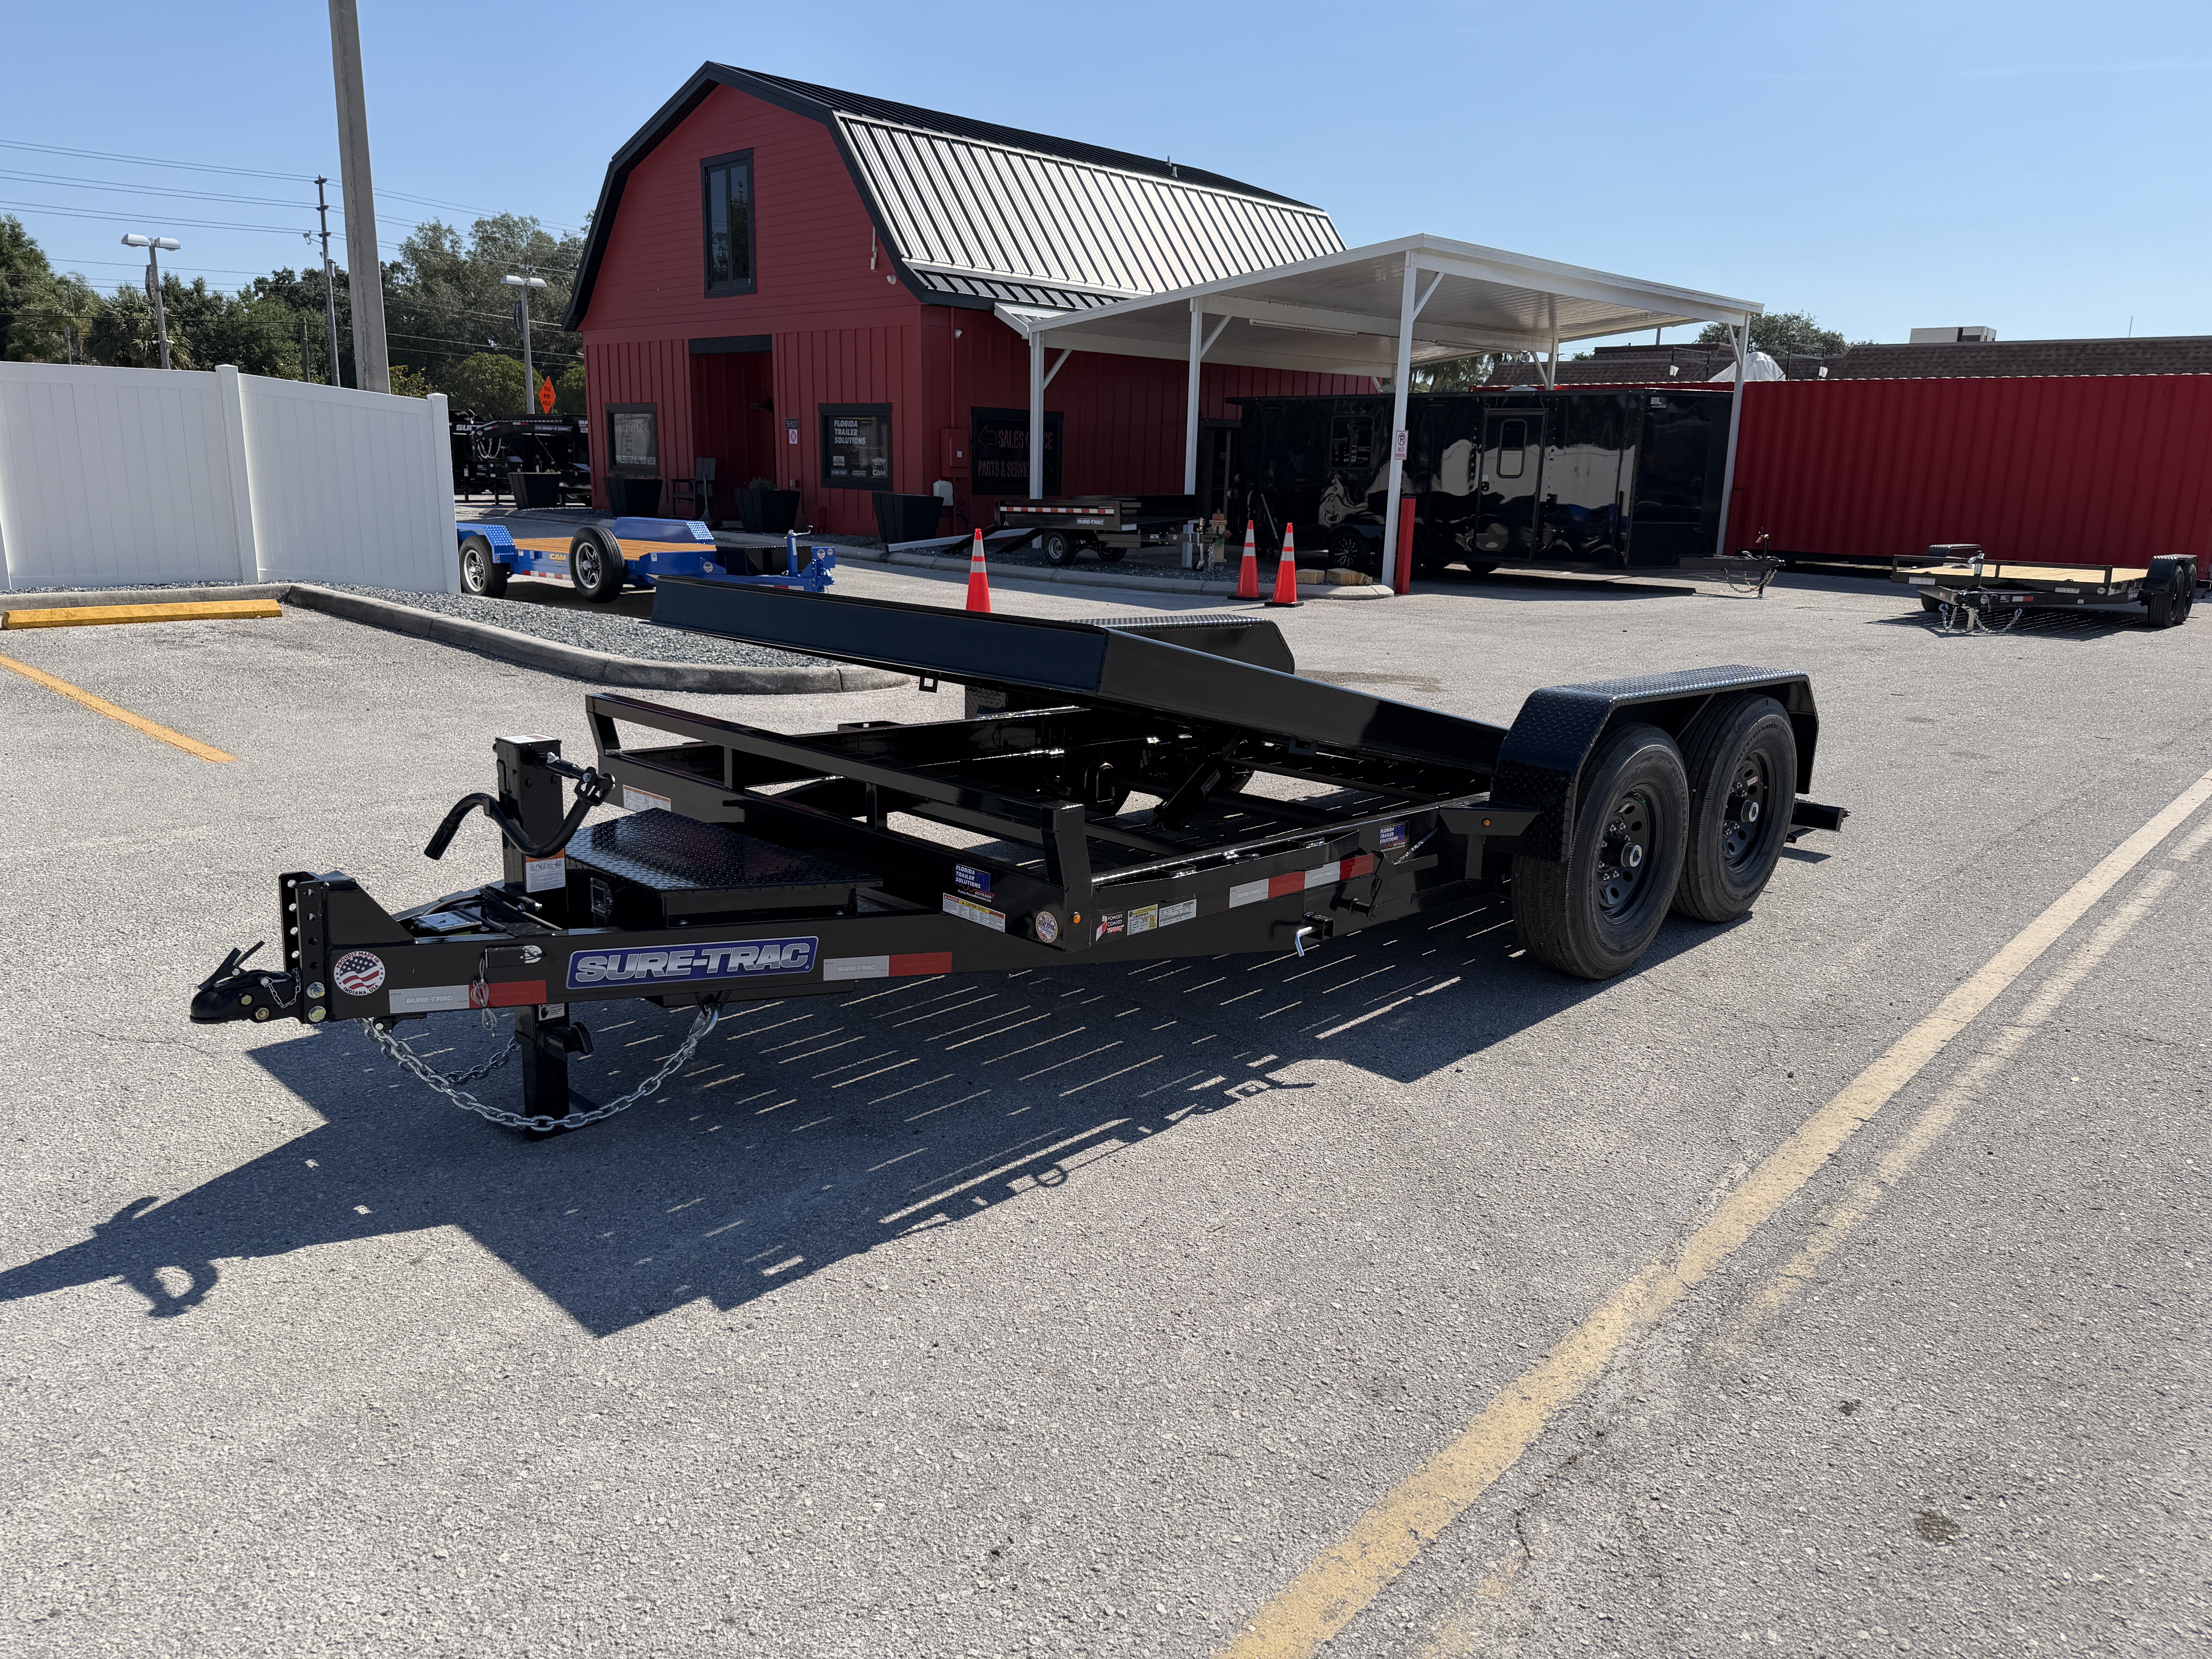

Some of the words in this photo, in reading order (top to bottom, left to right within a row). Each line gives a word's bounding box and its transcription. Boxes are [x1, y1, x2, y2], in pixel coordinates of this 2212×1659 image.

[998, 429, 1024, 448] SALES
[978, 460, 999, 477] PARTS
[1001, 460, 1006, 477] &
[956, 865, 975, 875] FLORIDA
[956, 871, 975, 881] TRAILER
[955, 877, 981, 888] SOLUTIONS
[336, 952, 357, 969] PROUDLY
[575, 943, 811, 982] SURE-TRAC
[343, 987, 369, 995] INDIANA,
[406, 995, 453, 1004] SURE-TRAC
